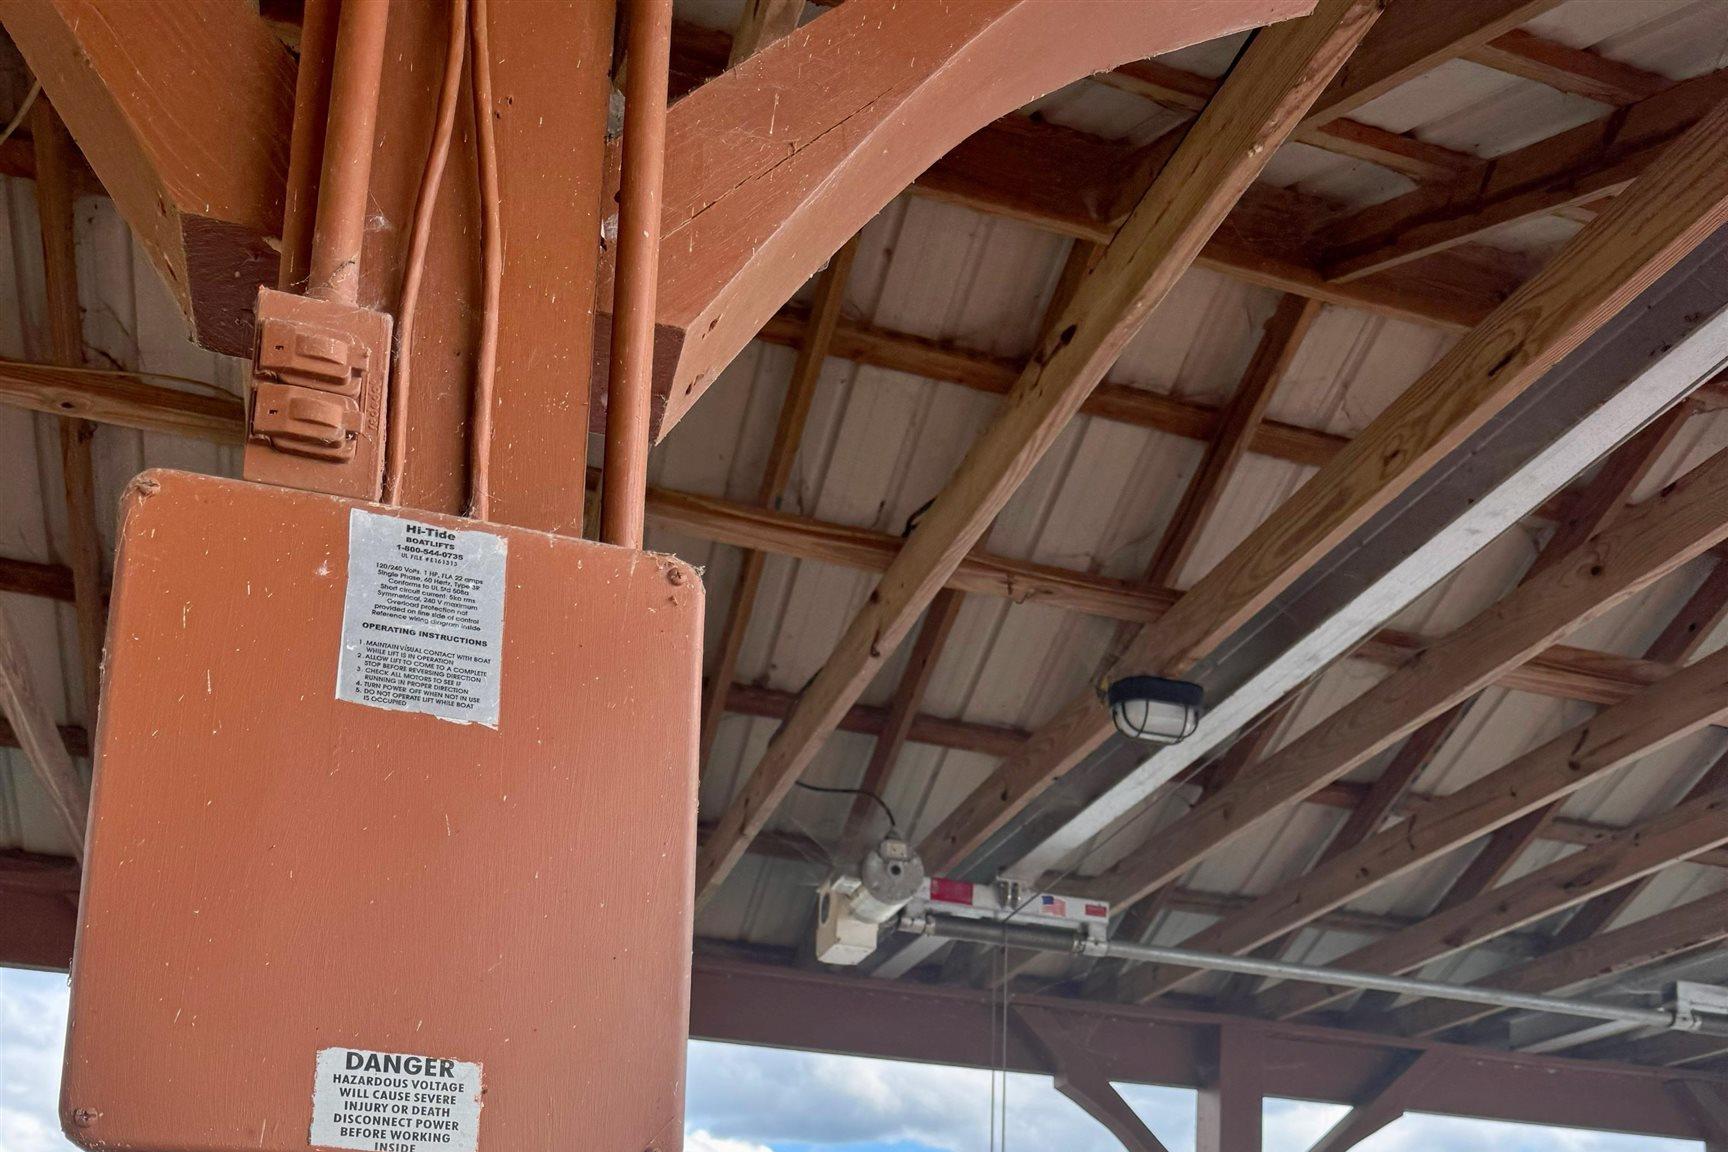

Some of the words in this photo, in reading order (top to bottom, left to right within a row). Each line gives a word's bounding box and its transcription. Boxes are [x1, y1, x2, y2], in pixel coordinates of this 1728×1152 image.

[406, 524, 456, 540] Hi-Tide
[406, 537, 455, 550] BOATLIFTS
[396, 544, 463, 560] 1-800-544-0735
[376, 562, 402, 571] 120/240
[377, 569, 398, 578] Single
[454, 582, 470, 590] Type
[388, 578, 421, 588] Conforms
[380, 583, 397, 591] Short
[400, 586, 420, 595] circuit
[374, 604, 405, 613] provided
[387, 598, 419, 608] Overload
[420, 604, 455, 614] protection
[444, 601, 477, 611] maximum
[371, 610, 407, 620] Reference
[409, 615, 428, 624] wiring
[430, 619, 459, 628] diagram
[362, 622, 416, 636] OPERATING
[419, 631, 487, 647] INSTRUCTIONS
[366, 640, 399, 650] MAINTAIN
[400, 645, 422, 653] VISUAL
[424, 649, 455, 659] CONTACT
[366, 647, 385, 655] WHILE
[417, 655, 454, 665] OPERATION
[365, 668, 388, 676] CHECK
[404, 673, 431, 682] MOTORS
[383, 663, 406, 671] BEFORE
[409, 667, 444, 677] REVERSING
[447, 673, 481, 683] DIRECTION
[413, 661, 434, 669] COME
[453, 667, 487, 677] COMPLETE
[365, 674, 396, 683] RUNNING
[407, 681, 432, 689] PROPER
[434, 685, 468, 694] DIRECTION
[383, 684, 406, 692] POWER
[423, 690, 443, 698] WHEN
[371, 696, 406, 706] OCCUPIED
[392, 693, 421, 701] OPERATE
[345, 1051, 455, 1078] DANGER
[333, 1074, 408, 1089] HAZARDOUS
[411, 1080, 464, 1093] VOLTAGE
[340, 1087, 369, 1099] WILL
[372, 1090, 411, 1102] CAUSE
[413, 1093, 456, 1105] SEVERE
[344, 1100, 389, 1113] INJURY
[391, 1105, 408, 1115] OR
[411, 1106, 450, 1117] DEATH
[333, 1113, 412, 1127] DISCONNECT
[415, 1119, 459, 1131] POWER
[340, 1127, 386, 1139] BEFORE
[390, 1130, 451, 1143] WORKING
